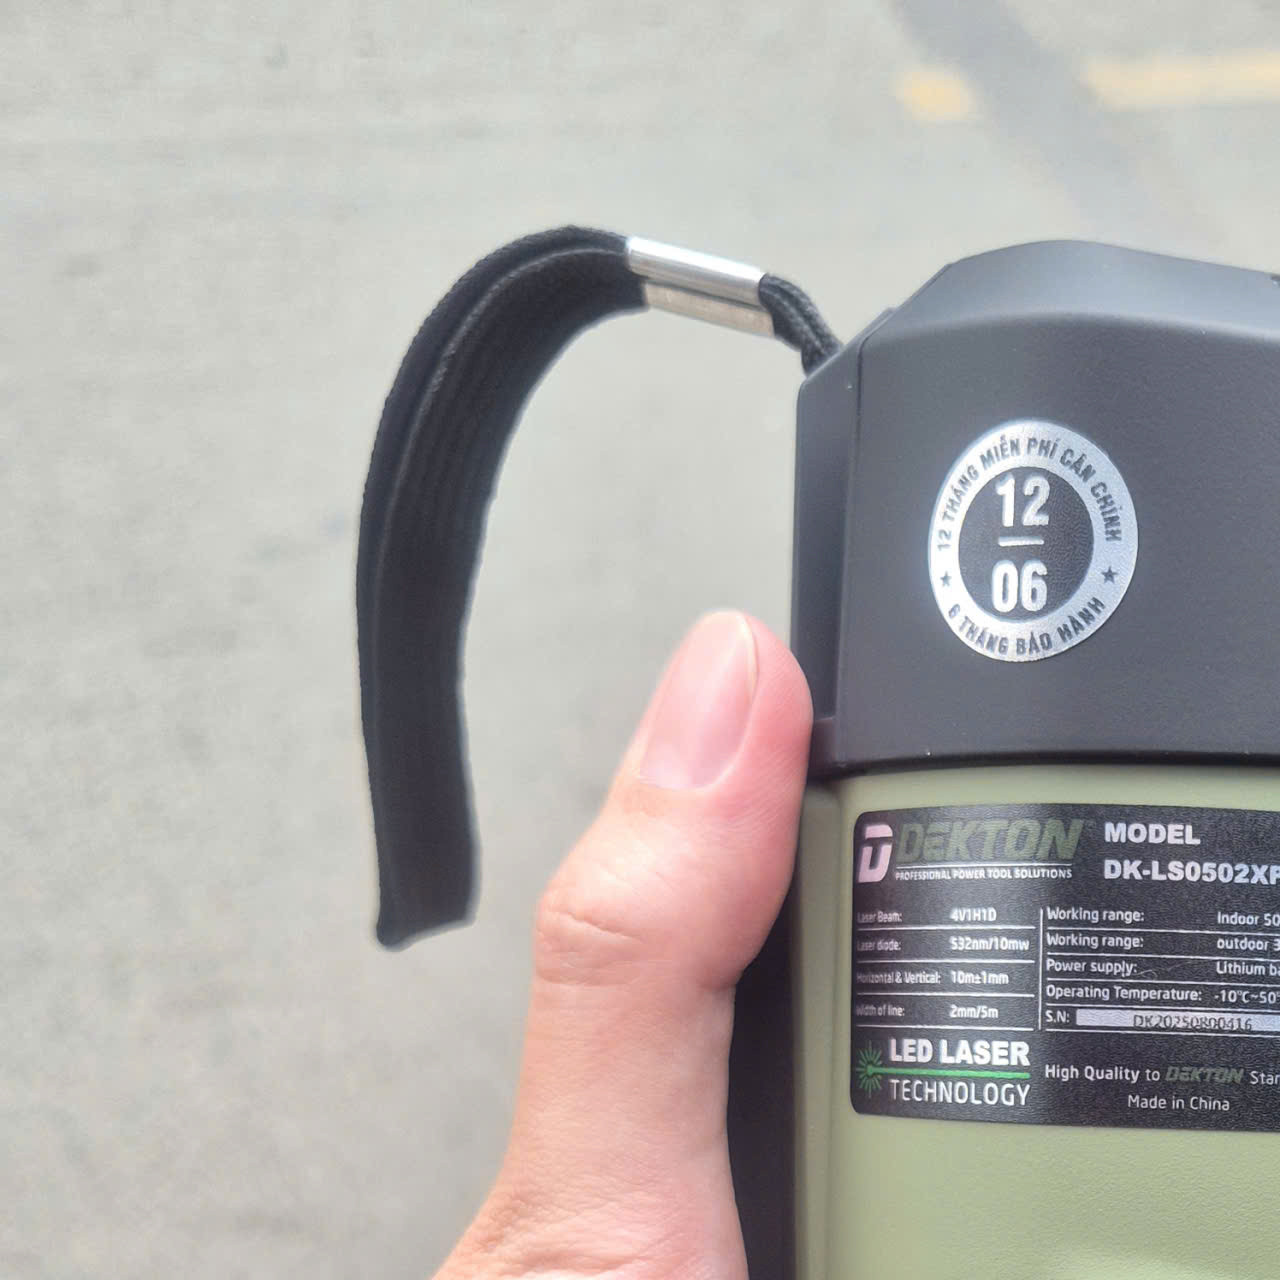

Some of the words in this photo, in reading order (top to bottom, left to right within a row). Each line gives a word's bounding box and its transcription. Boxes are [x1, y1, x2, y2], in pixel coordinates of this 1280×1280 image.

[1027, 437, 1061, 459] PHÍ
[942, 465, 979, 522] THÁNG
[995, 473, 1050, 527] 12
[938, 530, 952, 551] 12
[991, 560, 1048, 613] 06
[948, 604, 961, 618] 6
[958, 615, 1010, 655] THÁNG
[896, 818, 1084, 863] DEKTON
[1104, 822, 1201, 845] MODEL
[895, 868, 951, 881] PROFESSIONAL
[953, 868, 986, 880] POWER
[987, 868, 1012, 880] TOOL
[1014, 868, 1073, 880] SOLUTIONS
[950, 907, 997, 922] 4V1H1D
[1047, 906, 1099, 924] Working
[1103, 910, 1145, 924] range:
[1217, 911, 1259, 926] Indoor
[950, 936, 1030, 951] 532nm/10mw
[1046, 932, 1099, 949] Working
[1102, 936, 1144, 950] range:
[1217, 938, 1268, 952] outdoor
[1046, 959, 1087, 972] Power
[1090, 961, 1138, 977] supply:
[1216, 961, 1266, 976] Lithium
[1046, 984, 1110, 1001] Operating
[1114, 986, 1202, 1002] Temperature:
[950, 1004, 999, 1018] 2mm/5m
[1045, 1010, 1070, 1025] S.N:
[889, 1037, 933, 1063] LED
[940, 1039, 1031, 1067] LASER
[1045, 1064, 1080, 1082] High
[1084, 1065, 1140, 1083] Quality
[1145, 1068, 1161, 1082] to
[1164, 1065, 1245, 1085] DEKTON
[890, 1079, 1031, 1106] TECHNOLOGY
[1128, 1094, 1167, 1110] Made
[1171, 1094, 1185, 1110] in
[1190, 1096, 1231, 1112] China
